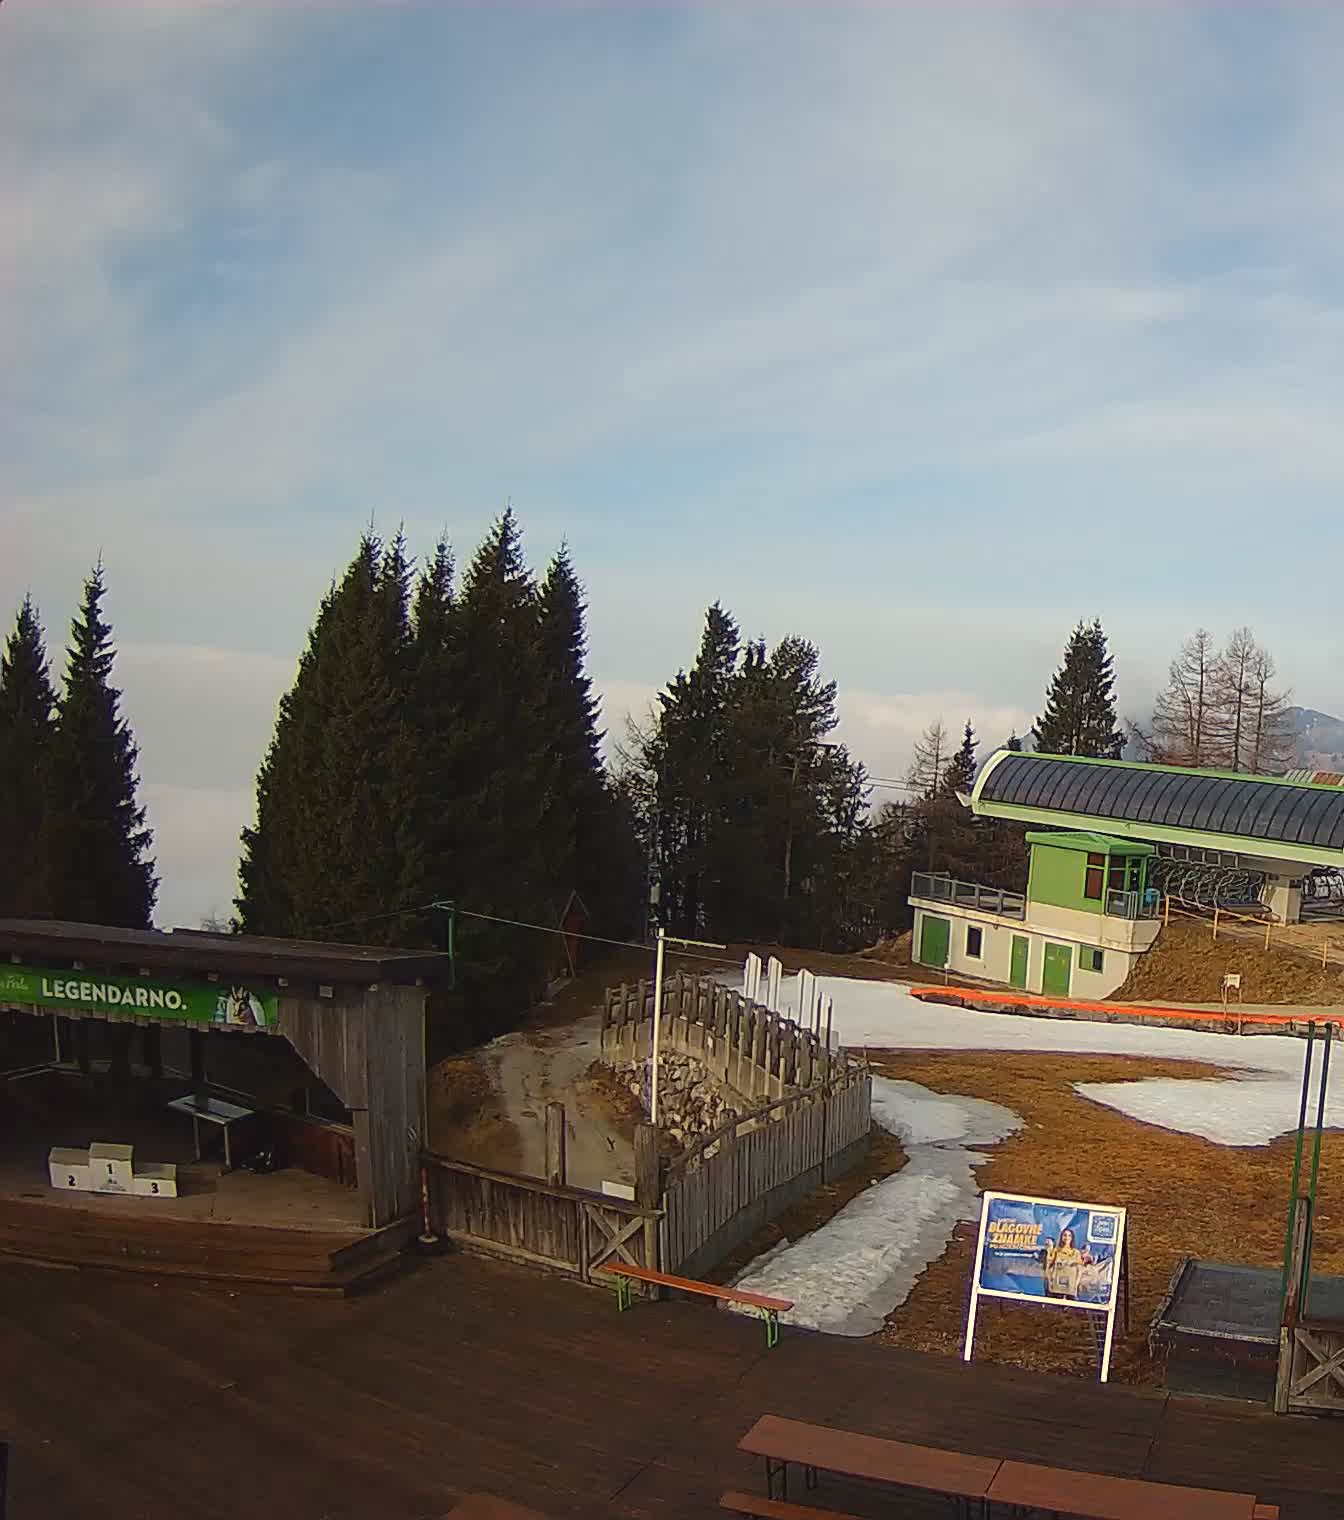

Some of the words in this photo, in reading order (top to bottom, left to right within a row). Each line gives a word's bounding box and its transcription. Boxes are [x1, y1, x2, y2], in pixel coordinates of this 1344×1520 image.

[41, 977, 188, 1011] LEGENDARNO.
[106, 1163, 113, 1175] 1
[68, 1175, 76, 1187] 2
[150, 1182, 159, 1194] 3
